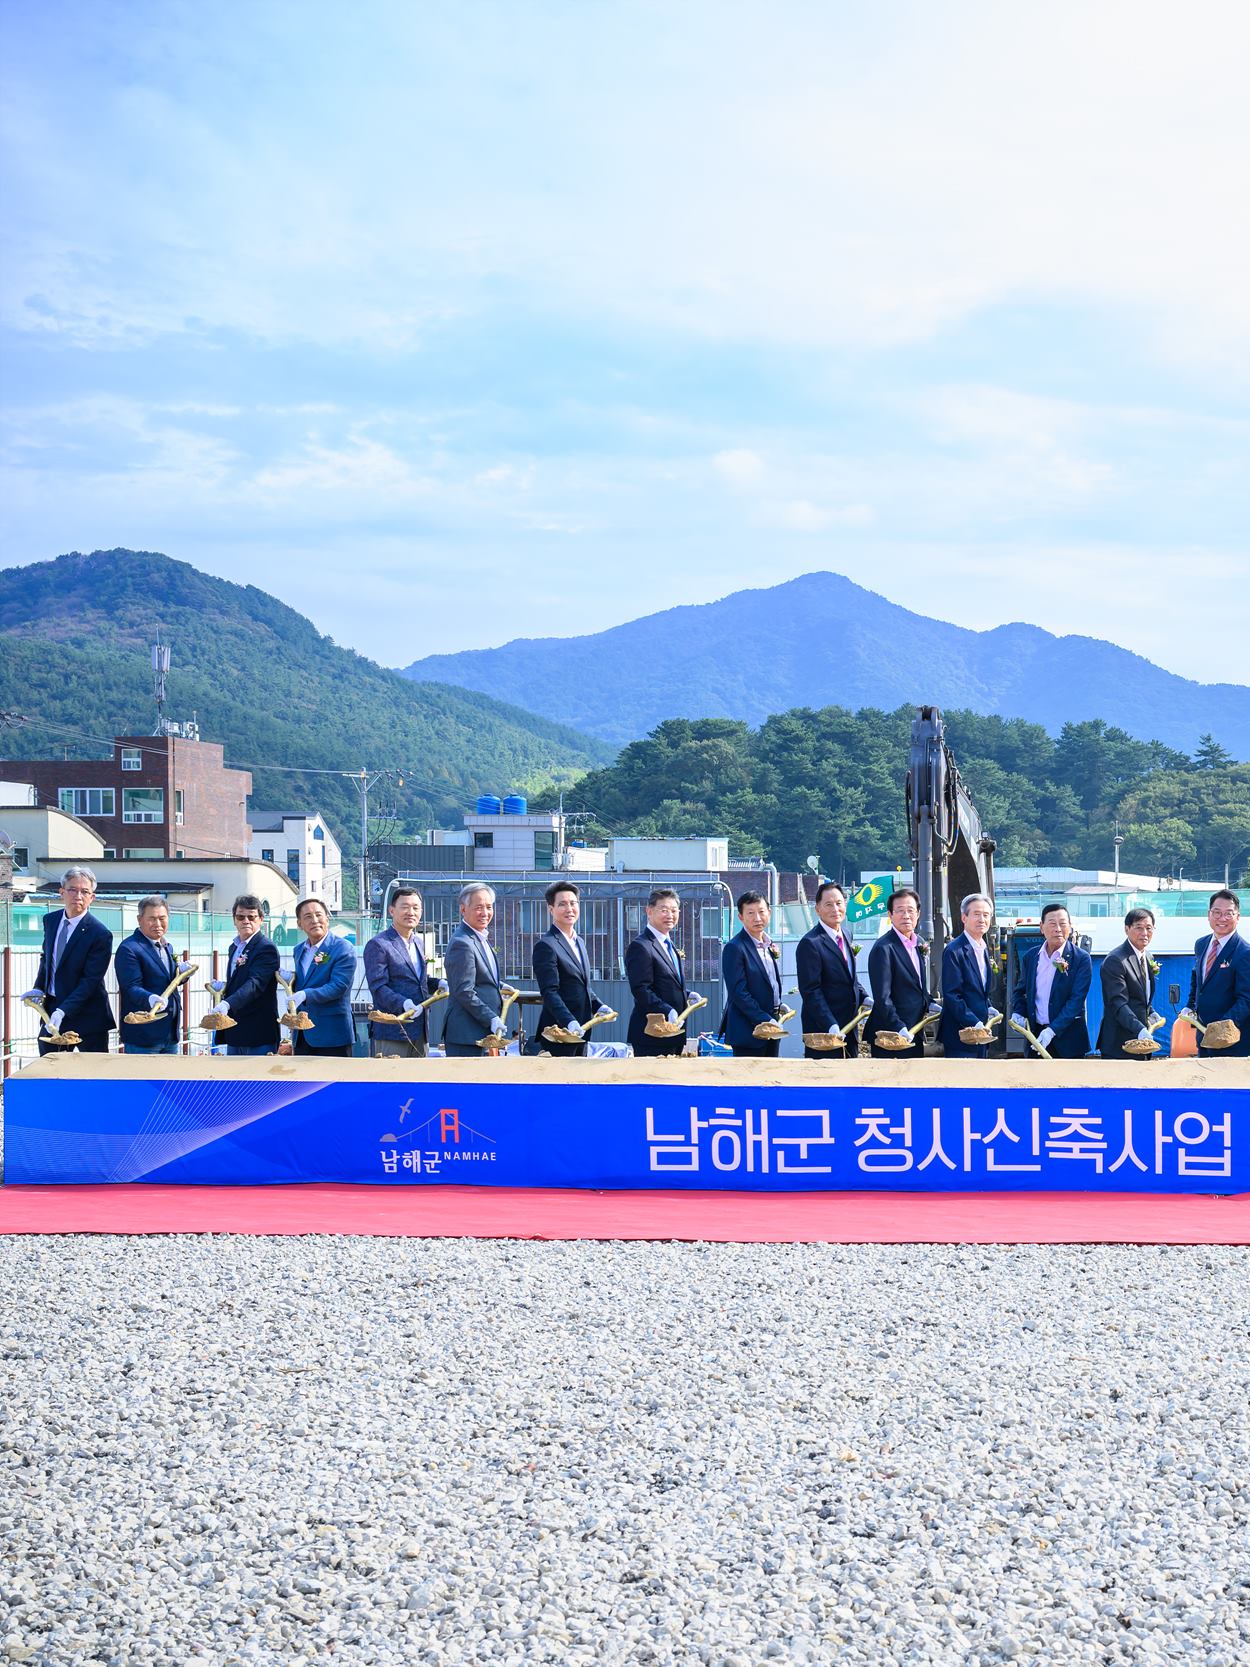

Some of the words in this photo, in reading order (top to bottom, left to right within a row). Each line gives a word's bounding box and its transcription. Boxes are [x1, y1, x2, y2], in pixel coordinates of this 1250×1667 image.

[380, 1149, 442, 1174] 남해군
[444, 1151, 497, 1161] NAMHAE
[645, 1106, 835, 1174] 남해군
[853, 1107, 1232, 1177] 청사신축사업
